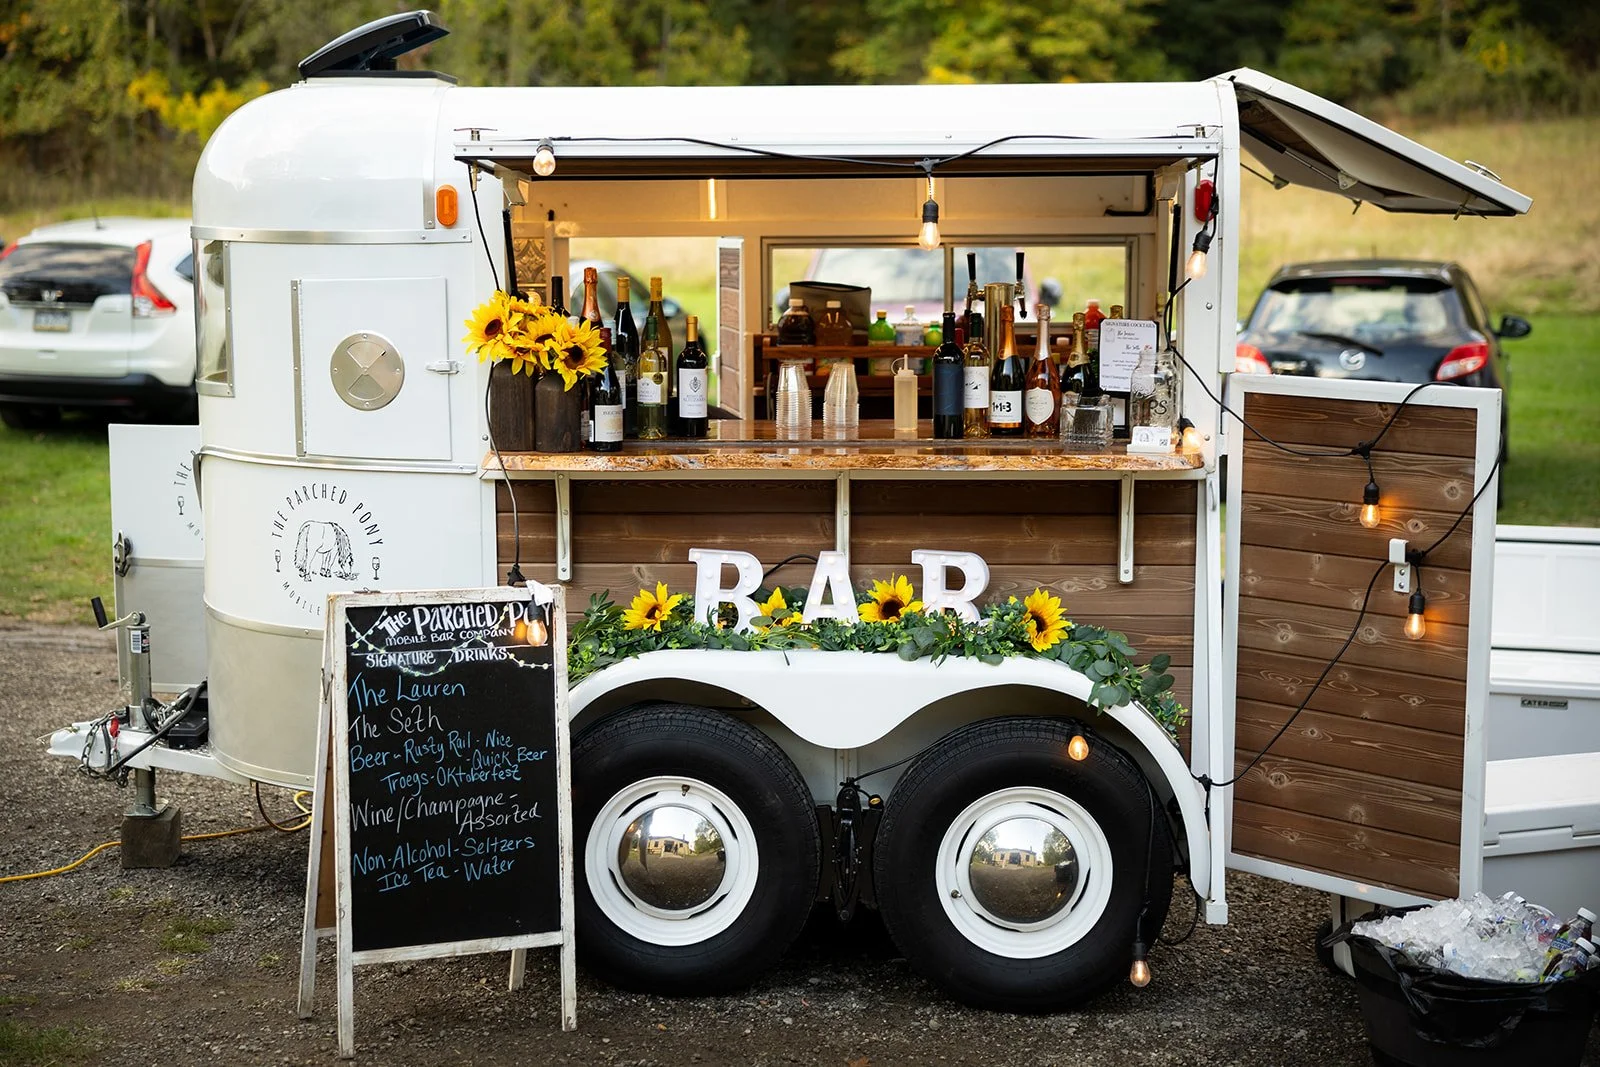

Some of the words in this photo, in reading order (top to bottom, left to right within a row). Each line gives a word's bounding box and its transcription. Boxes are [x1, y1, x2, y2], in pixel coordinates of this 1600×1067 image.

[992, 401, 1011, 412] 1+1=3
[173, 462, 192, 486] THE
[271, 510, 288, 538] THE
[286, 483, 348, 511] PARCHED
[352, 502, 384, 546] PONY
[282, 581, 321, 616] MOBILE
[688, 547, 991, 635] BAR
[508, 601, 552, 629] PY
[454, 648, 508, 663] DRINKS
[347, 672, 390, 713] The
[397, 674, 466, 702] Lauren
[1521, 699, 1549, 707] CATER
[347, 713, 382, 742] The
[387, 704, 445, 735] Seth
[447, 730, 471, 758] Rail
[485, 729, 514, 748] Nice
[517, 746, 548, 763] Beer
[459, 802, 543, 835] Assorted
[377, 872, 411, 893] Ice
[414, 861, 450, 883] Tea
[464, 856, 515, 882] Water
